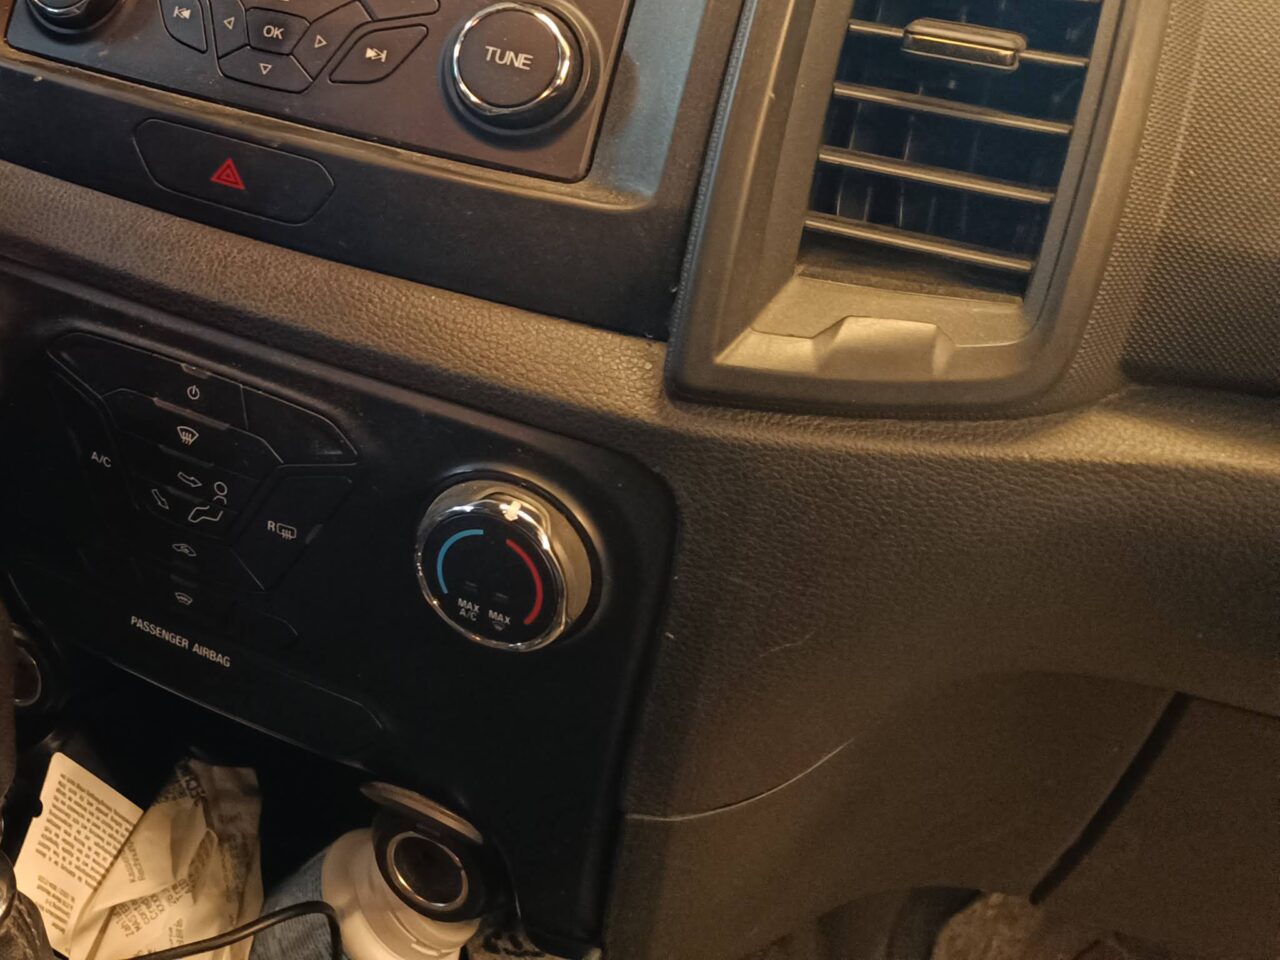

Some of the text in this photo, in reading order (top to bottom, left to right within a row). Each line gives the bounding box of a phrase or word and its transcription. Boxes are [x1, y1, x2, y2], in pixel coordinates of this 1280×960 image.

[263, 24, 285, 40] OK
[484, 45, 533, 70] TUNE
[91, 451, 112, 468] A/C
[457, 597, 480, 614] MAX
[458, 608, 477, 622] A/C
[488, 610, 511, 625] MAX
[130, 615, 231, 668] PASSENGER AIRBAG
